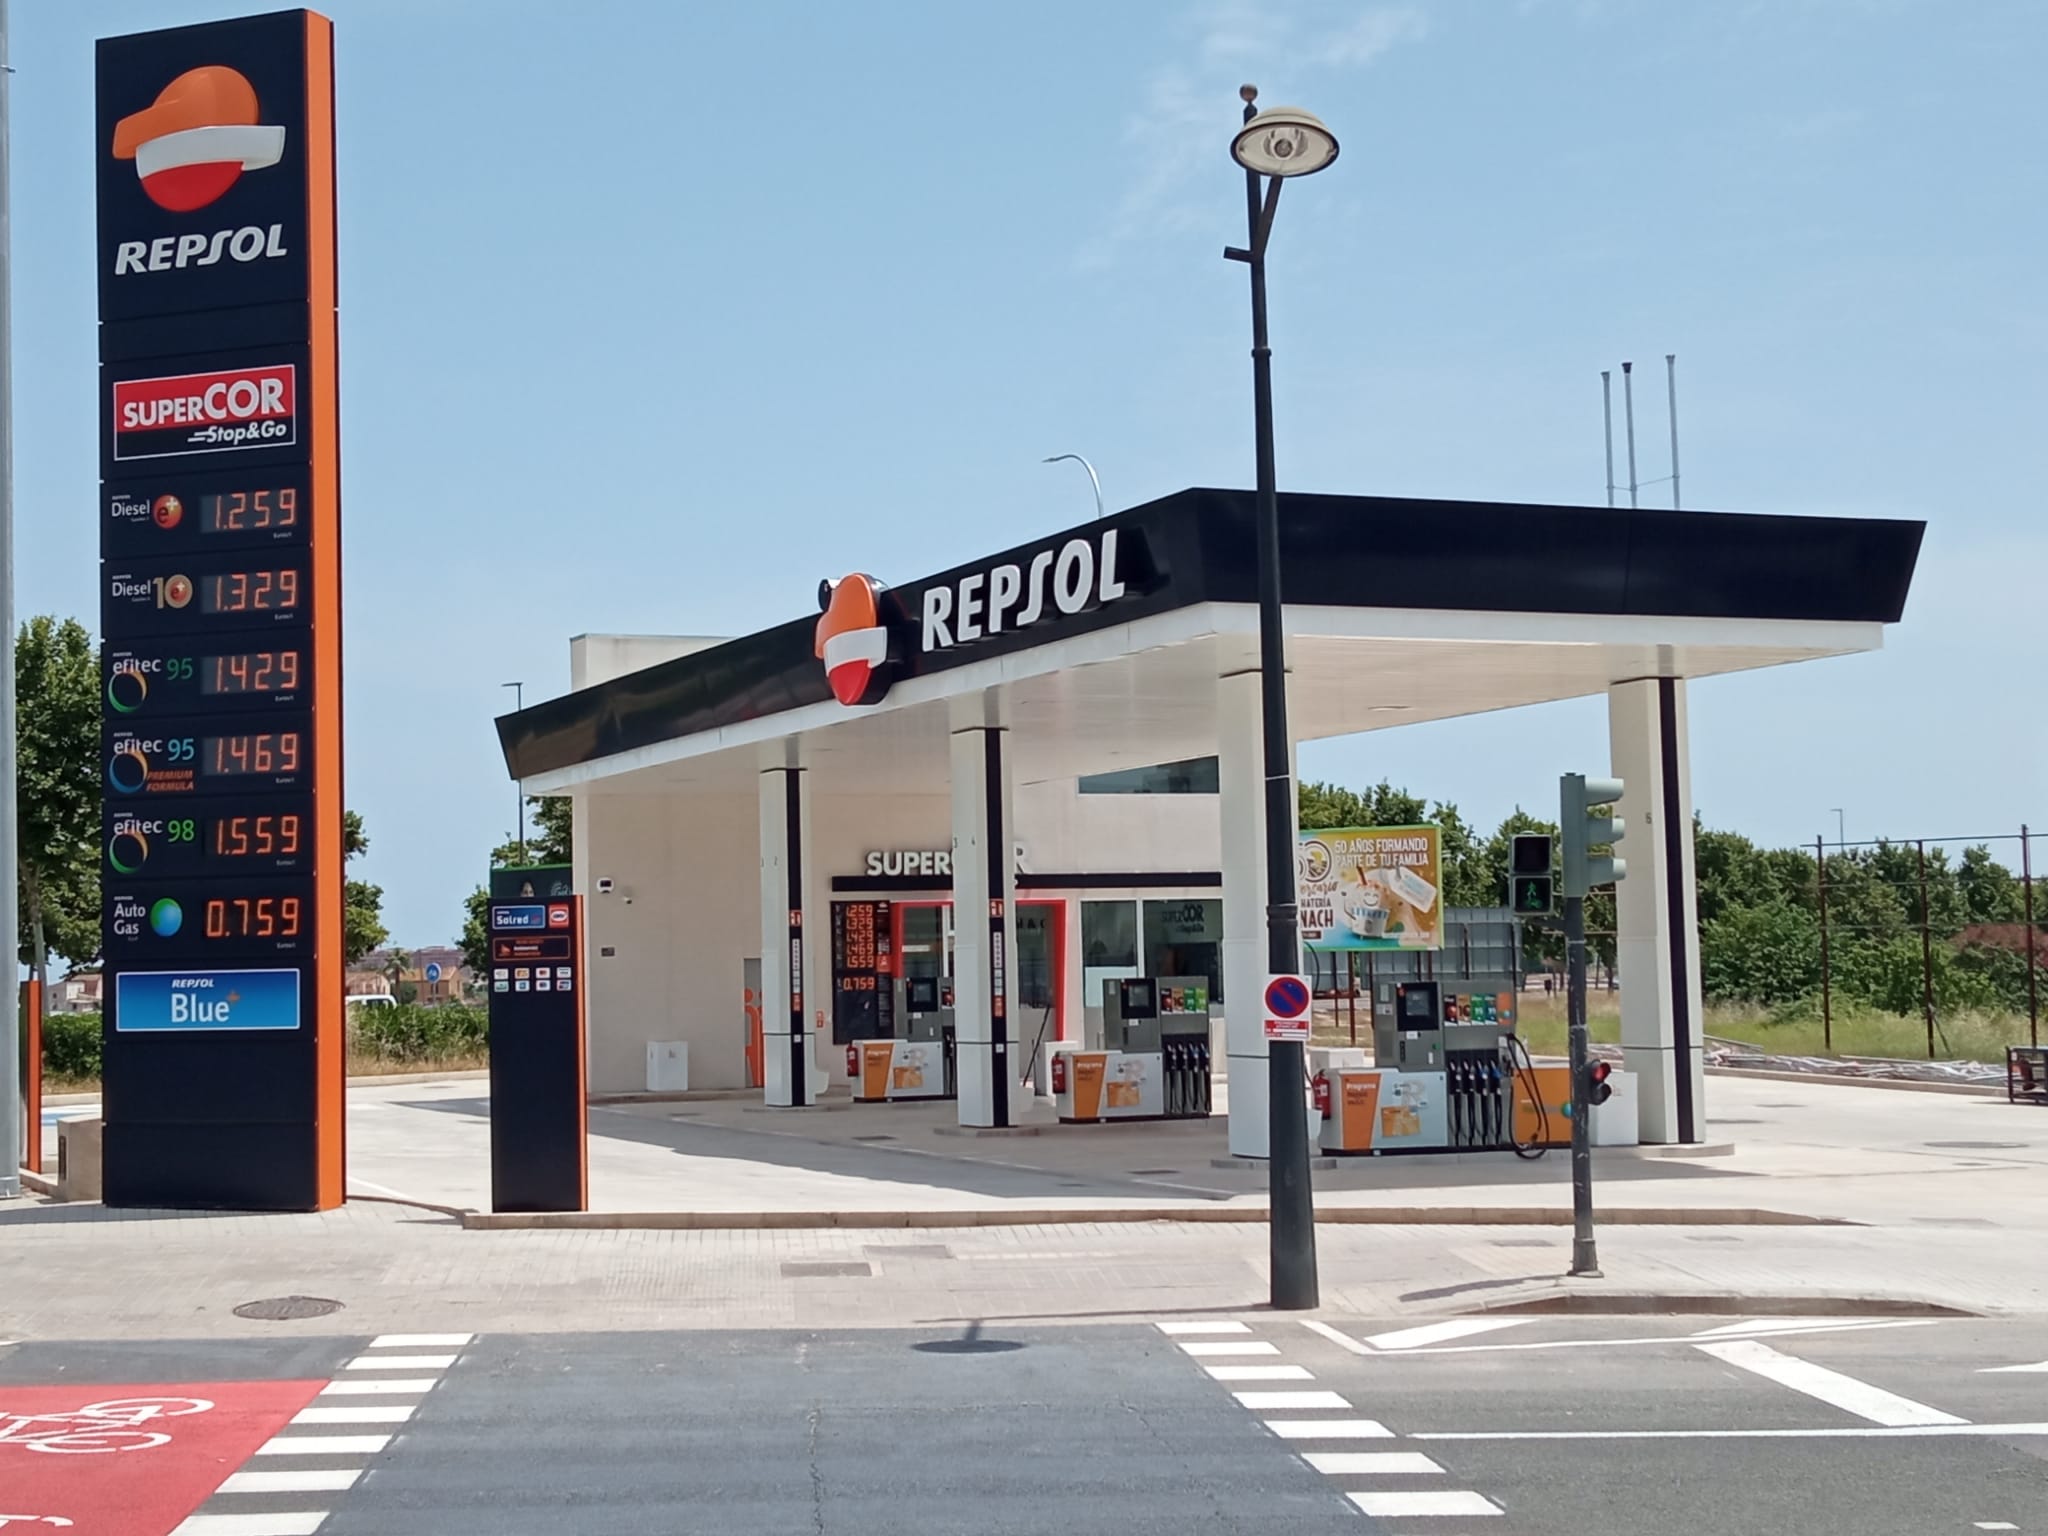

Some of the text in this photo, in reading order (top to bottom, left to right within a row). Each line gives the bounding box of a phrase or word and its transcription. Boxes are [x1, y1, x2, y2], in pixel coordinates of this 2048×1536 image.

[115, 224, 287, 275] REPSOL
[123, 378, 286, 428] SUPERCOR
[206, 421, 287, 445] Stop&Go
[111, 499, 150, 517] Diesel
[215, 488, 296, 529] 1.259
[112, 580, 151, 597] Diesel
[215, 570, 297, 611] 1.329
[922, 529, 1126, 652] REPSOL
[112, 658, 193, 681] efitec 95
[216, 652, 297, 692] 1.429
[114, 738, 194, 761] efitec 95
[216, 733, 298, 773] 1.469
[113, 819, 195, 842] efitec 98
[217, 816, 298, 855] 1.559
[1376, 837, 1428, 852] FORMANDO
[1366, 854, 1377, 866] DE
[114, 903, 146, 918] Auto
[207, 898, 298, 937] 0.759
[113, 920, 139, 935] Gas
[172, 979, 214, 988] REPSOL
